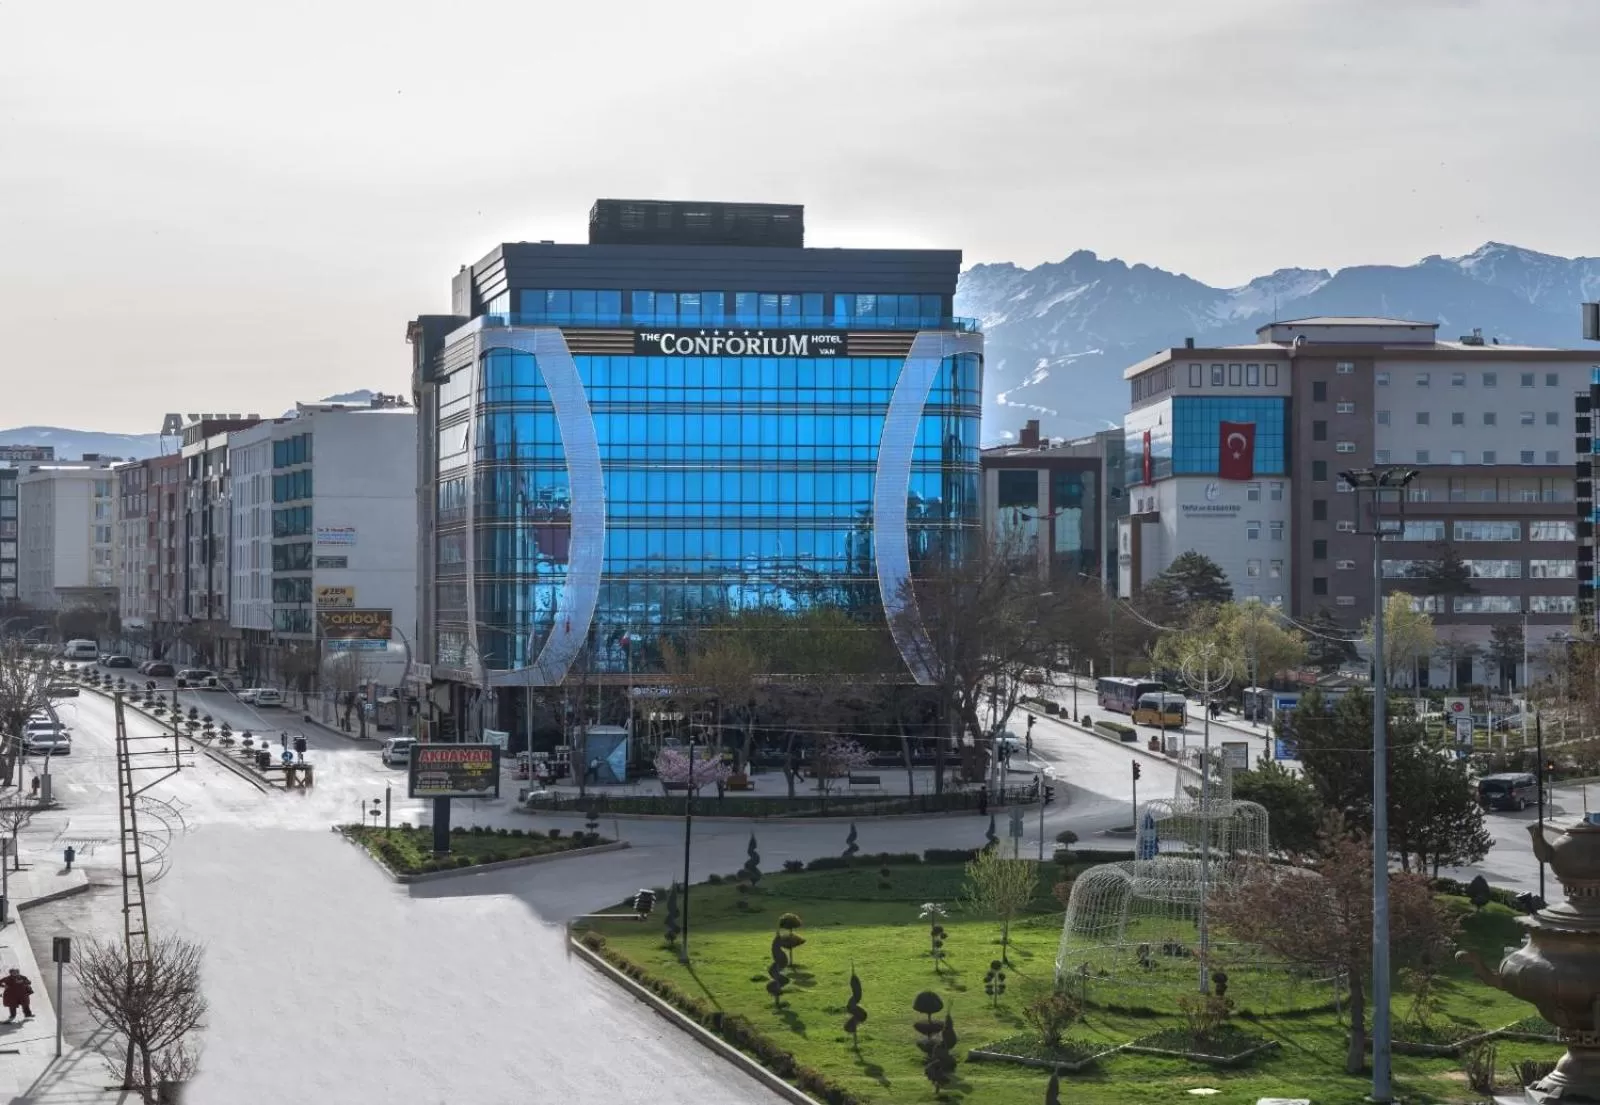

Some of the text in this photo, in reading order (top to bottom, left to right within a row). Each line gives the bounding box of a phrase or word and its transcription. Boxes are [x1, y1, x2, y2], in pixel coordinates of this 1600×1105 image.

[640, 333, 843, 355] THE CONFORIUM HOTEL
[418, 749, 493, 763] AKDAMAR
